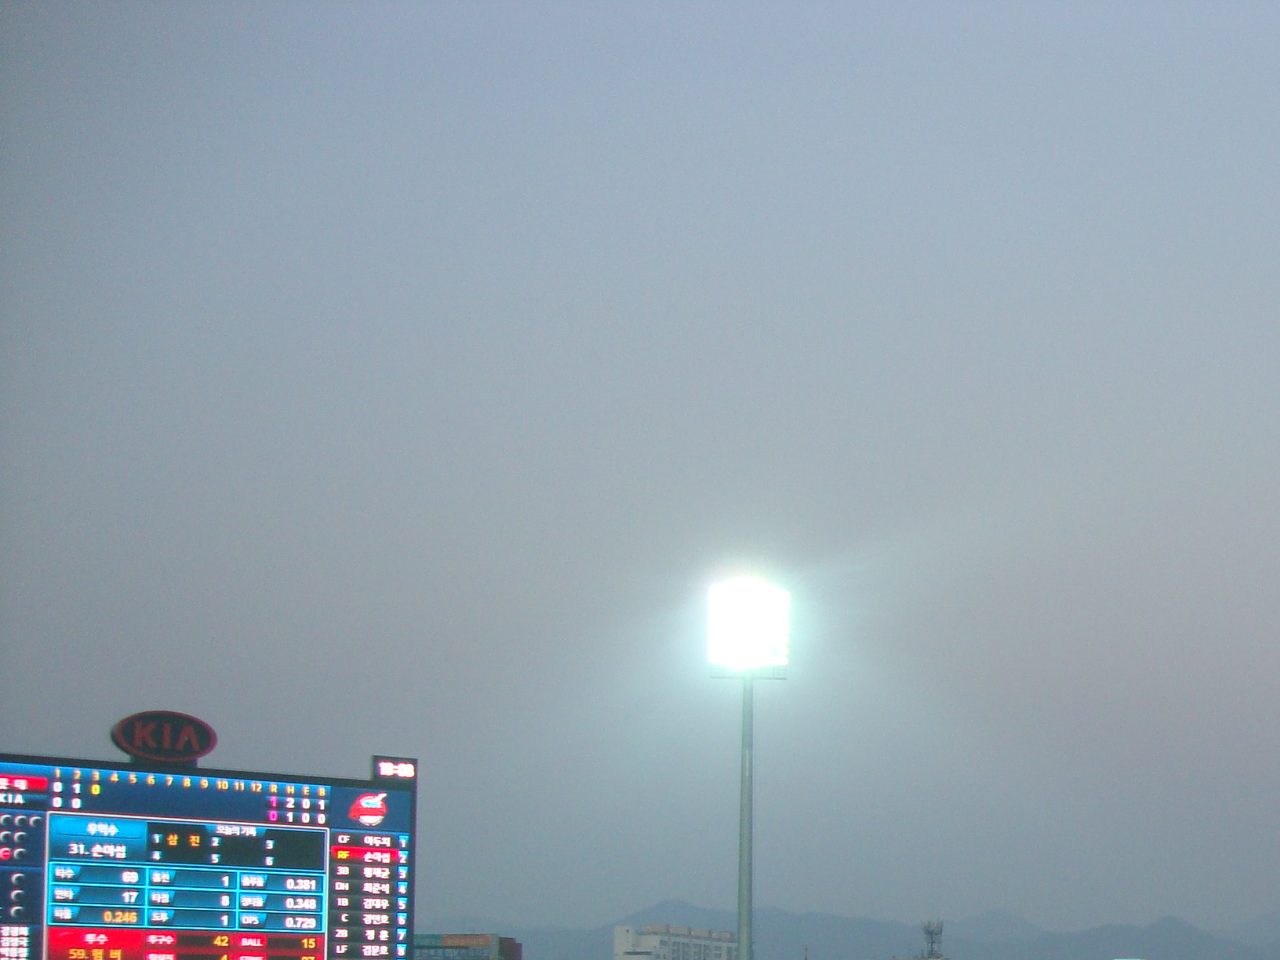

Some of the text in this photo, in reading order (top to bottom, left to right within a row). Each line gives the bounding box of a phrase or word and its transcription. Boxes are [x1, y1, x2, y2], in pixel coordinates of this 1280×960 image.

[133, 721, 200, 751] KIA
[53, 781, 63, 793] 0
[72, 783, 81, 794] 1
[91, 784, 101, 795] 0
[269, 796, 277, 807] 1
[286, 797, 295, 809] 2
[302, 798, 310, 809] 0
[317, 799, 325, 810] 1
[53, 796, 62, 808] 0
[72, 798, 81, 809] 0
[269, 810, 277, 822] 0
[286, 812, 294, 822] 1
[302, 812, 310, 823] 0
[317, 813, 326, 825] 0
[337, 835, 350, 844] CF
[222, 876, 229, 887] 1
[122, 892, 139, 903] 17
[221, 915, 229, 927] 1
[213, 936, 229, 947] 42
[241, 938, 316, 949] BALL 15
[336, 945, 348, 954] LF
